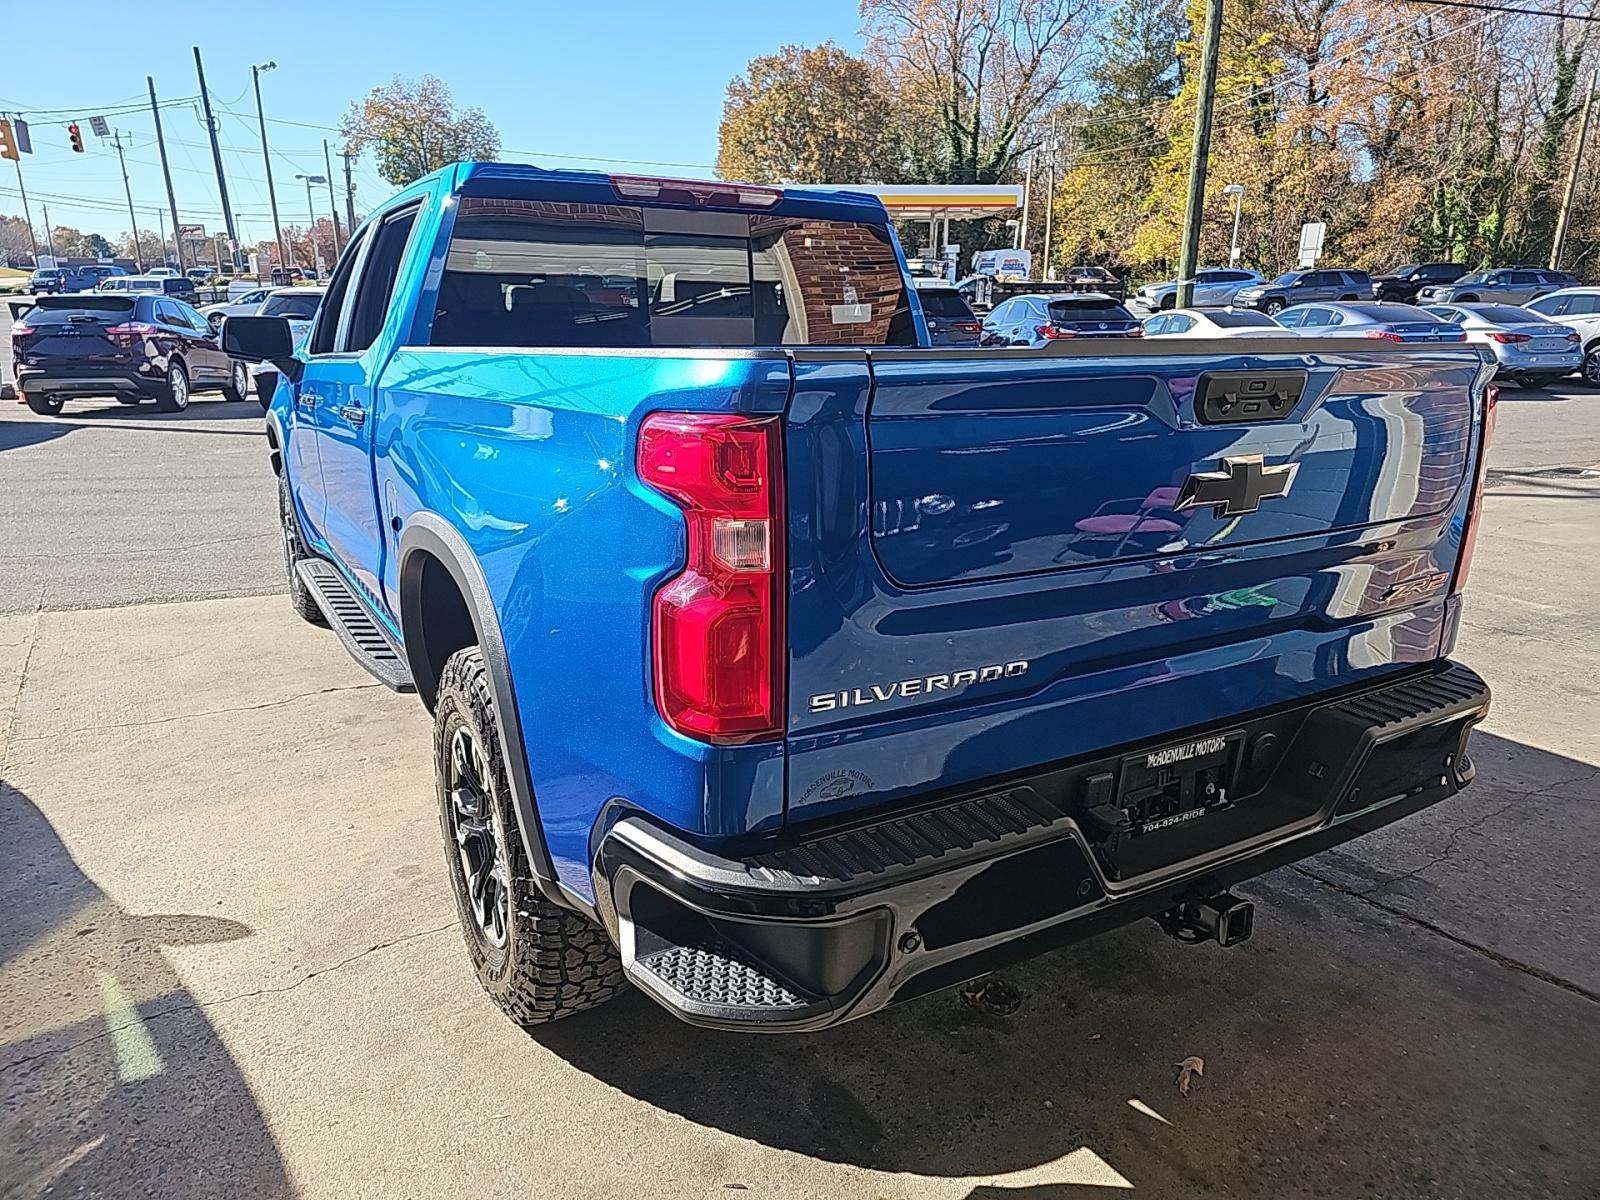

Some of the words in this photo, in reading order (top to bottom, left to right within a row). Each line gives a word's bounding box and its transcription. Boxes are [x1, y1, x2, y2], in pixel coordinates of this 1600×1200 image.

[808, 660, 1029, 712] SILVERADO
[1195, 736, 1226, 757] MOTORS
[847, 768, 876, 789] MOTORS
[1142, 808, 1205, 834] 704-824-RIDE
